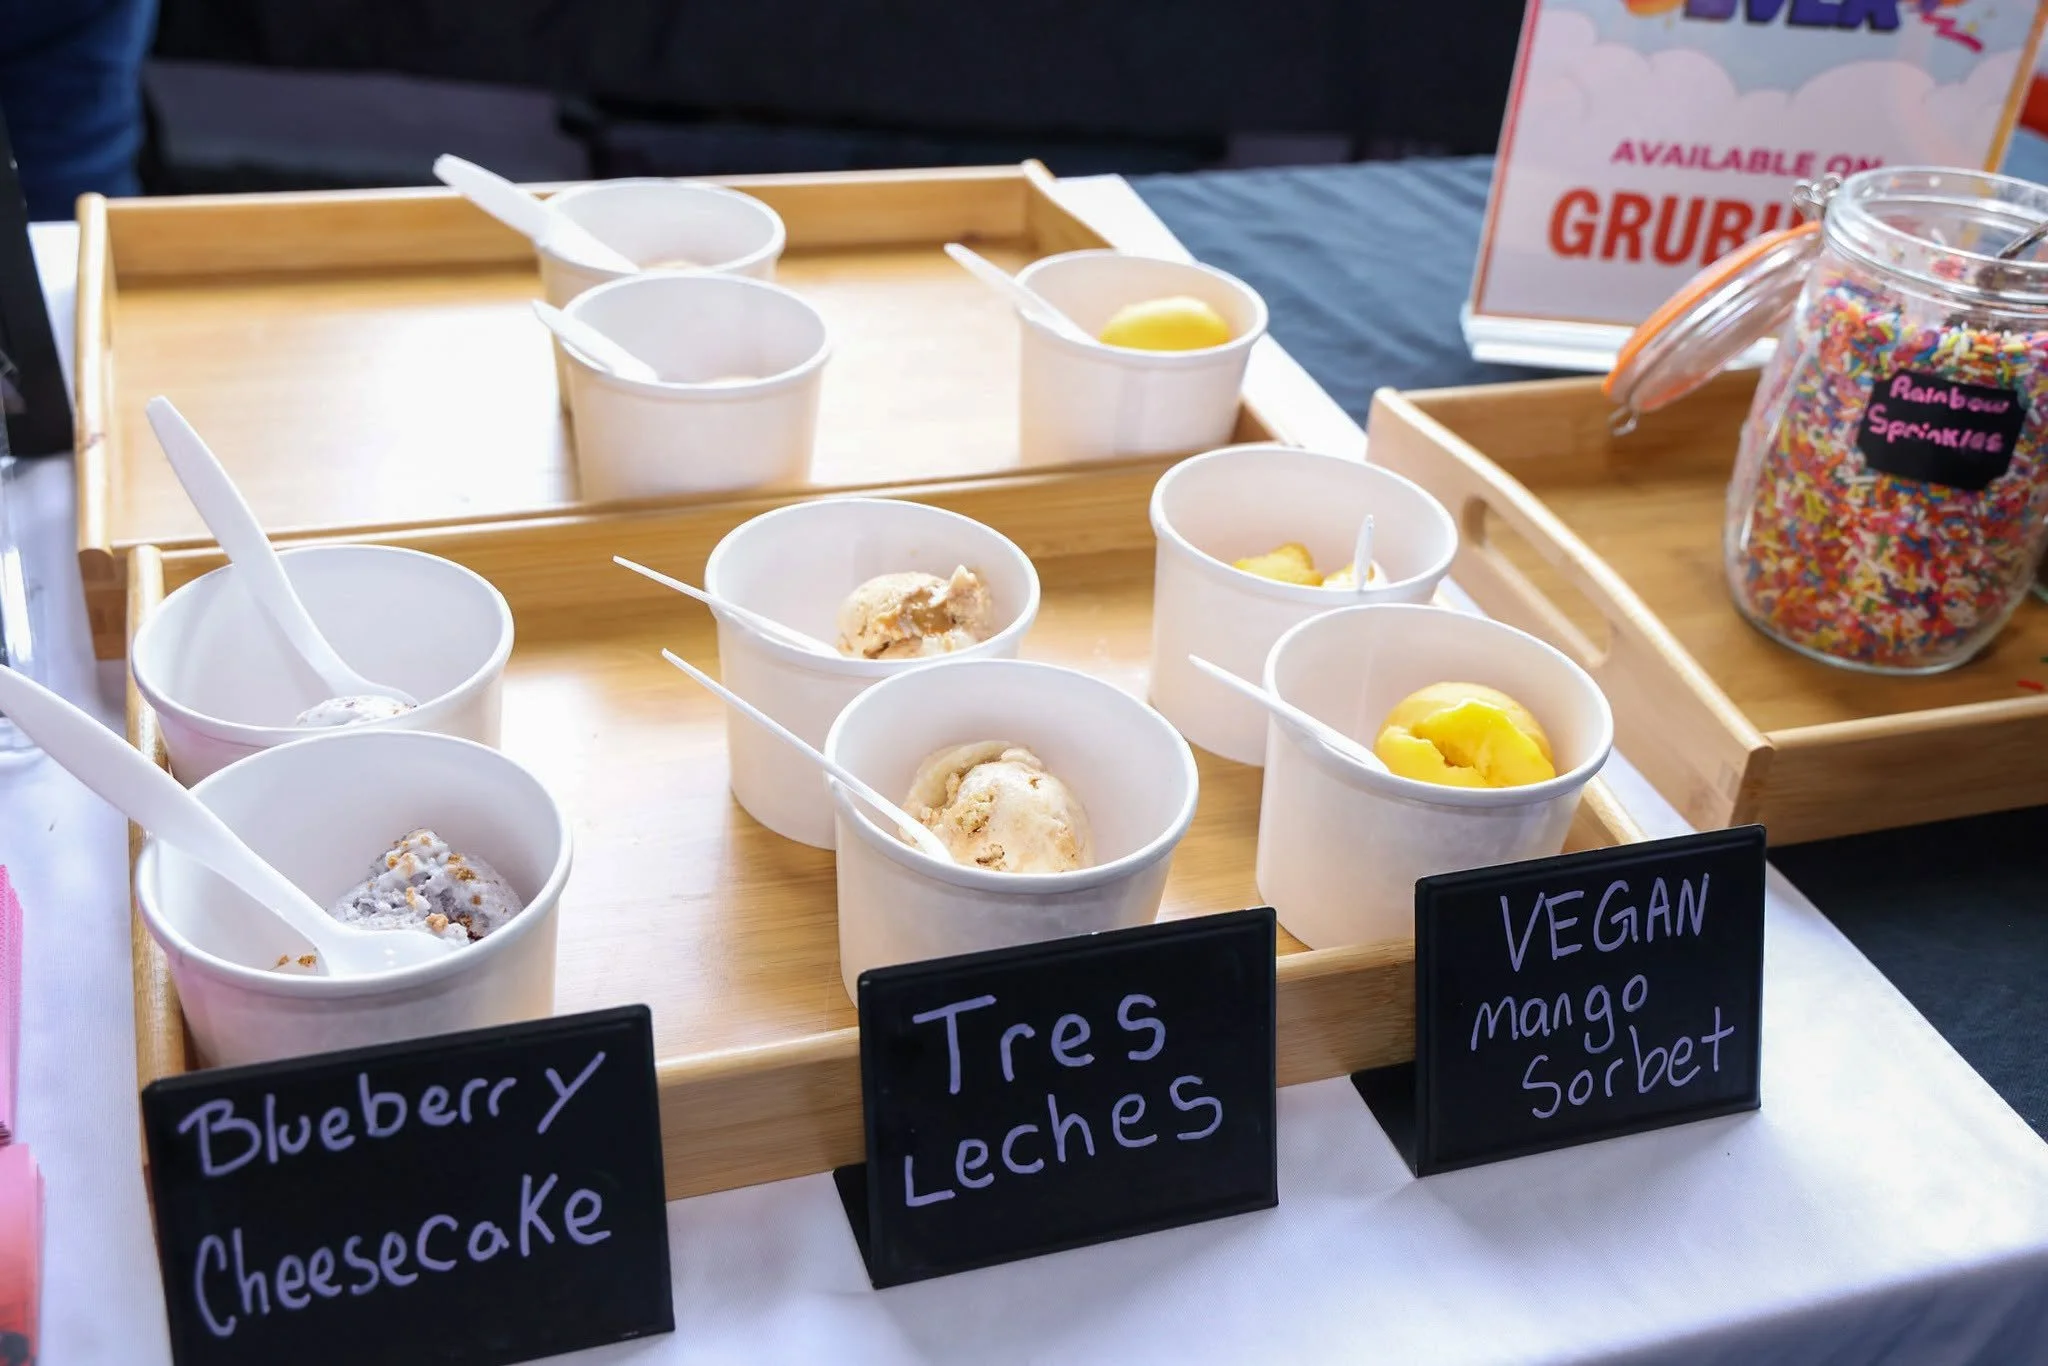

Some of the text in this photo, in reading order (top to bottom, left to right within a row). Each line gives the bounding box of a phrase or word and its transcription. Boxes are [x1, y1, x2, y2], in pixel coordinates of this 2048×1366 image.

[1611, 141, 1816, 178] AVAILABLE
[1889, 374, 2010, 413] Rainbow
[1500, 872, 1710, 972] VEGAN
[912, 993, 1167, 1095] Tres
[1470, 974, 1649, 1054] mango
[1521, 1006, 1736, 1119] Sorbet
[904, 1075, 1224, 1207] Leches
